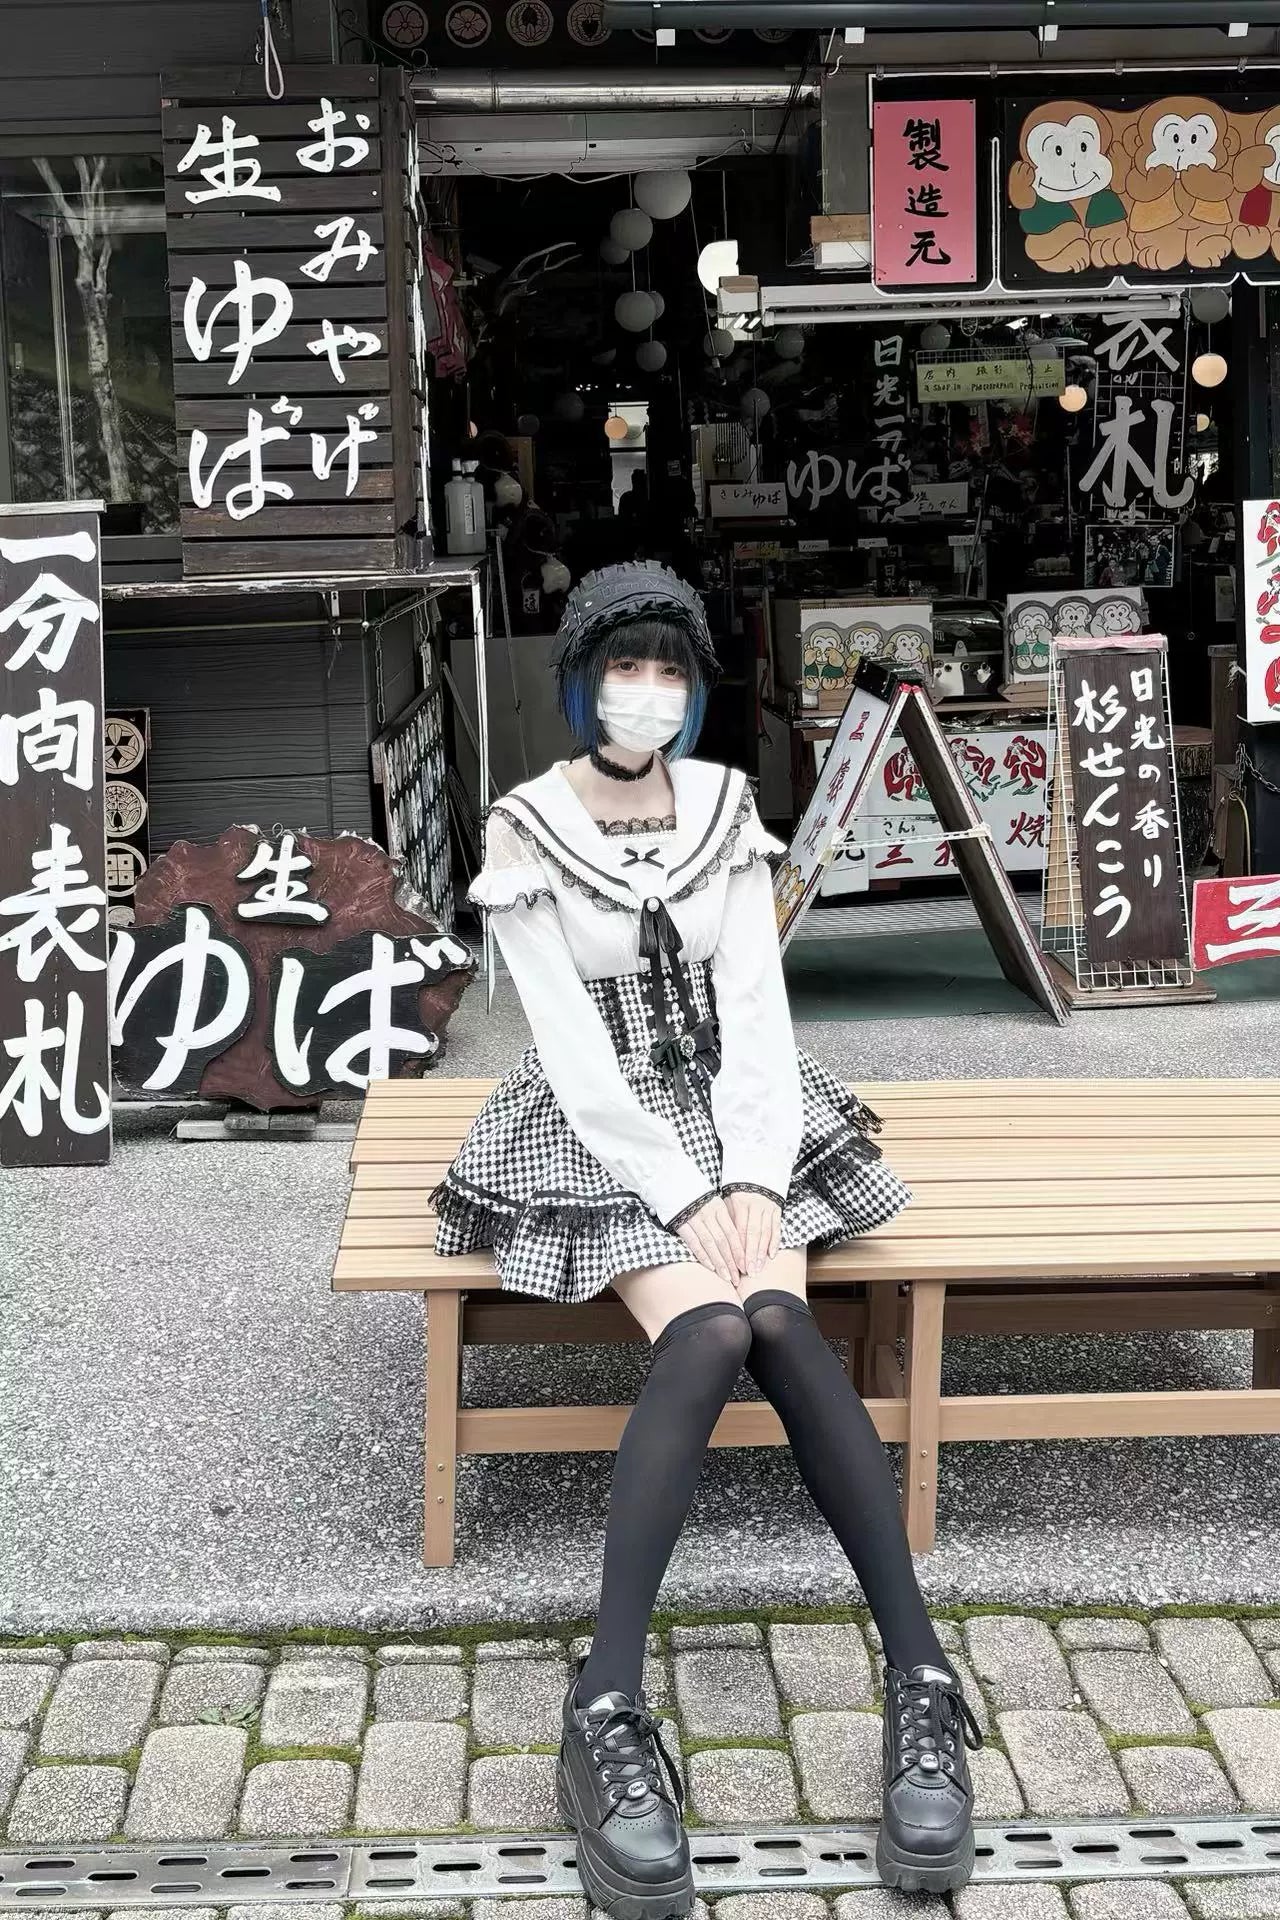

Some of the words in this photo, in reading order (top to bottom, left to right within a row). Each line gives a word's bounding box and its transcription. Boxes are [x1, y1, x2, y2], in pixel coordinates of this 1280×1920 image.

[903, 118, 951, 269] 製造元
[176, 115, 302, 521] 生ゆば
[297, 97, 382, 498] おみやげ
[787, 449, 912, 511] ゆば
[237, 834, 330, 923] 生
[1072, 679, 1132, 939] 杉せんこう
[1129, 667, 1170, 888] 日光の香り
[109, 906, 471, 1091] ゆば
